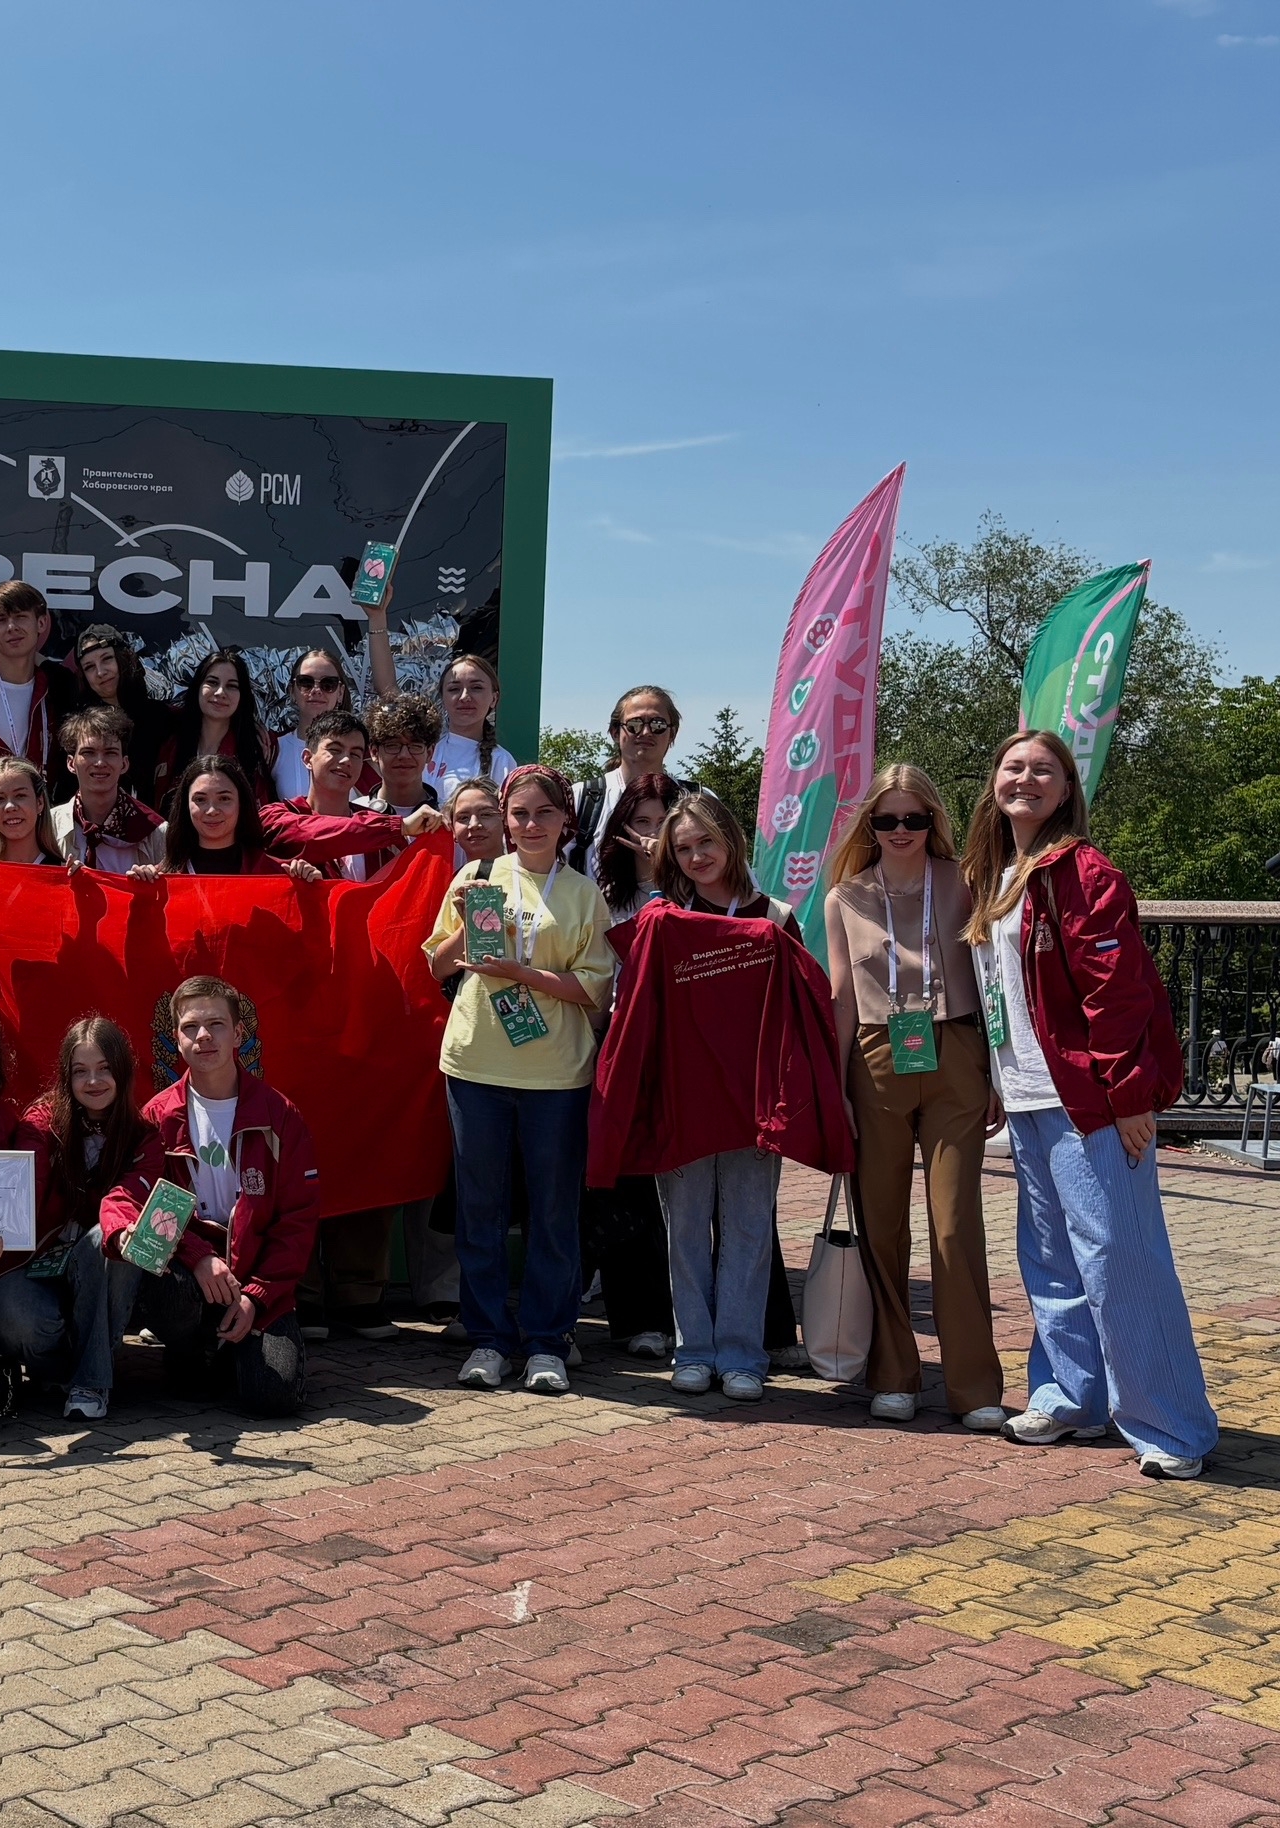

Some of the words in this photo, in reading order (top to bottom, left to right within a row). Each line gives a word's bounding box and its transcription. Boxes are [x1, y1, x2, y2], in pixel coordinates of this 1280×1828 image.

[82, 467, 154, 480] Правительство
[82, 479, 149, 492] Хабаровского
[150, 485, 173, 494] края
[259, 472, 301, 506] РСМ
[830, 531, 882, 806] СТУДВ
[1072, 631, 1115, 790] СТУДВ
[692, 947, 733, 961] Видишь
[735, 941, 753, 950] это
[675, 976, 691, 984] мы
[693, 964, 736, 980] стираем
[738, 954, 776, 969] границ
